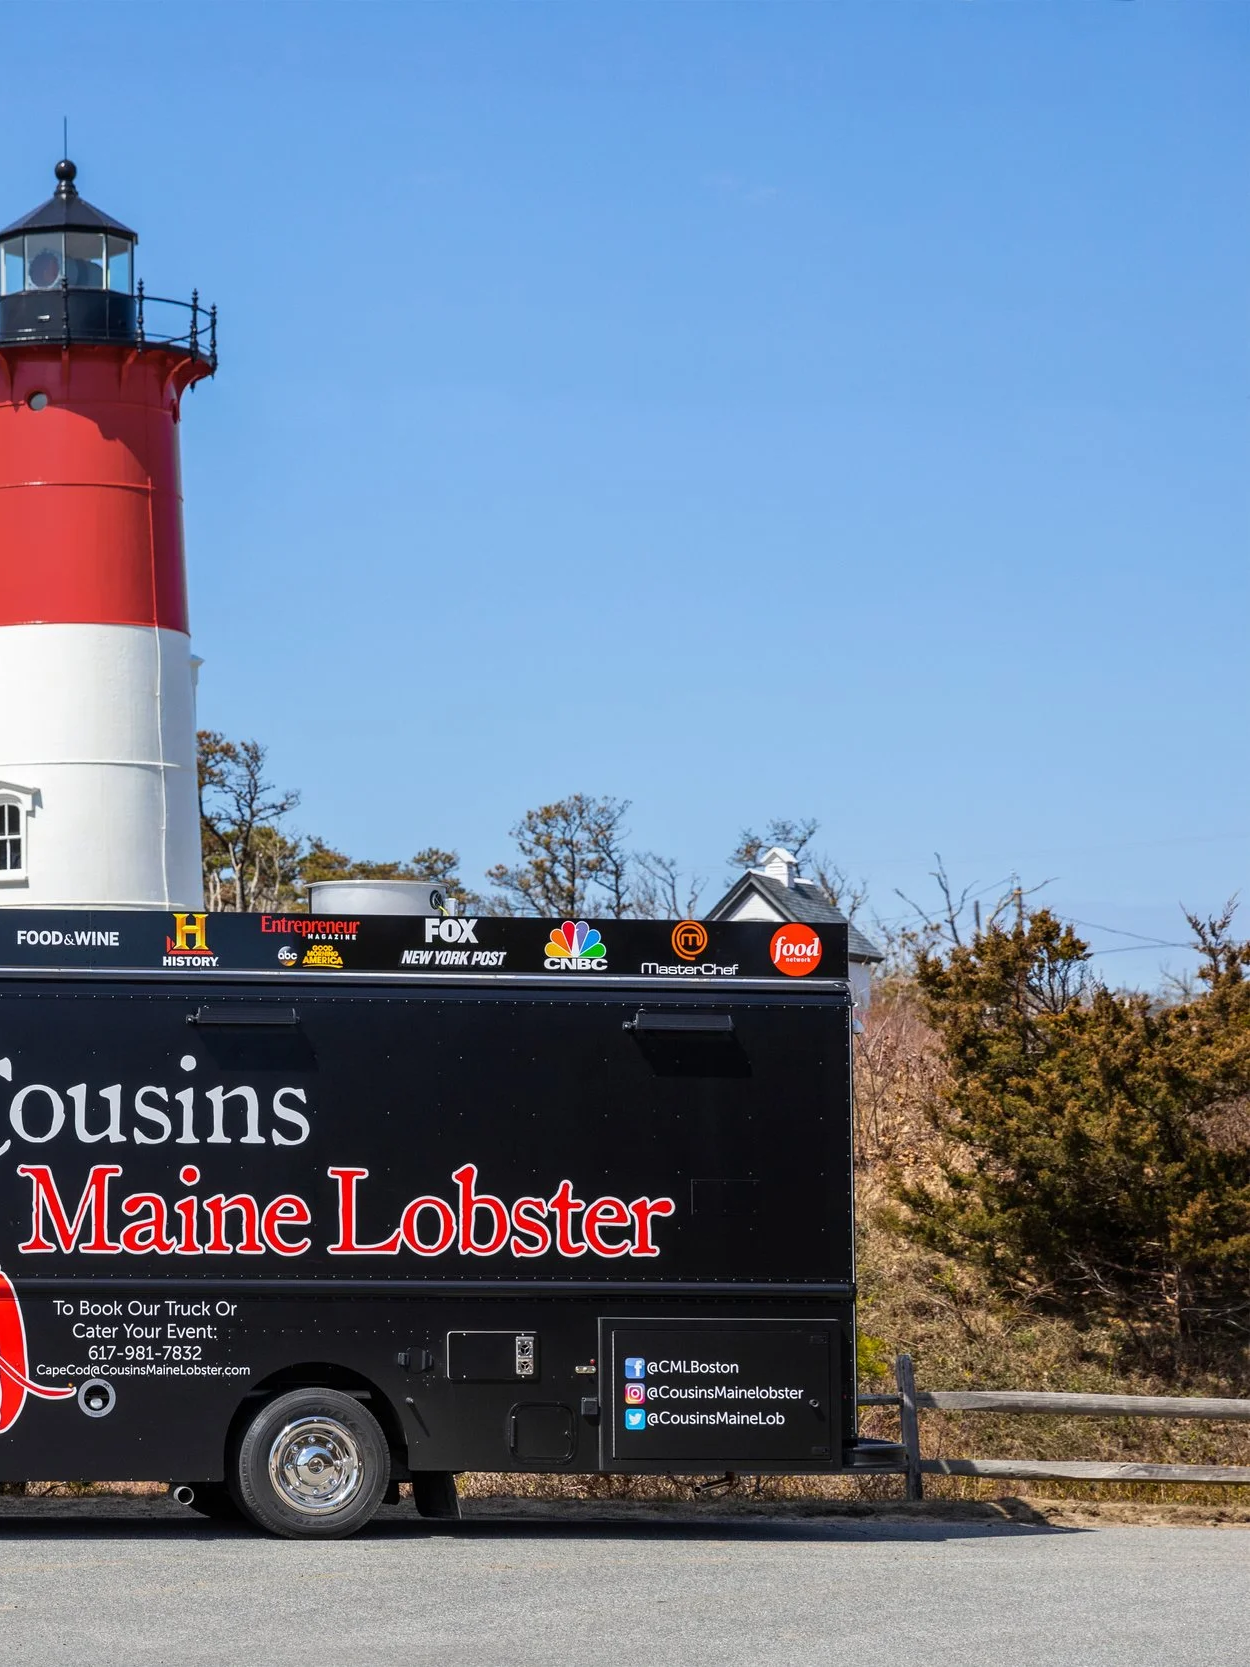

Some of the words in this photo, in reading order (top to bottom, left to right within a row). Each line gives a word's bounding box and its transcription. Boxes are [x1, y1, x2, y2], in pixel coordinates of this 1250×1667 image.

[173, 913, 209, 950] H
[261, 915, 361, 937] Entrepreneur
[425, 918, 478, 943] FOX
[277, 950, 298, 960] abc
[774, 936, 820, 964] food
[163, 956, 217, 966] HISTORY
[302, 956, 343, 965] AMERICA
[401, 950, 434, 965] NEW
[434, 951, 469, 965] YORK
[471, 951, 507, 966] POST
[544, 957, 607, 970] CNBC
[641, 963, 738, 975] MasterChef
[17, 1164, 311, 1256] Maine
[327, 1163, 676, 1257] Lobster
[53, 1301, 73, 1315] To
[80, 1301, 122, 1315] Book
[128, 1301, 160, 1315] Our
[165, 1301, 210, 1316] Truck
[216, 1301, 237, 1316] Or
[73, 1323, 118, 1338] Cater
[123, 1324, 162, 1338] Your
[167, 1324, 217, 1338] Event:
[89, 1346, 201, 1360] 617-981-7832
[36, 1363, 250, 1377] CapeCod@CousinsMaineLobster.com
[647, 1360, 738, 1375] @CMLBoston
[647, 1386, 803, 1400] @CousinsMainelobster
[647, 1411, 785, 1426] @CousinsMaineLob
